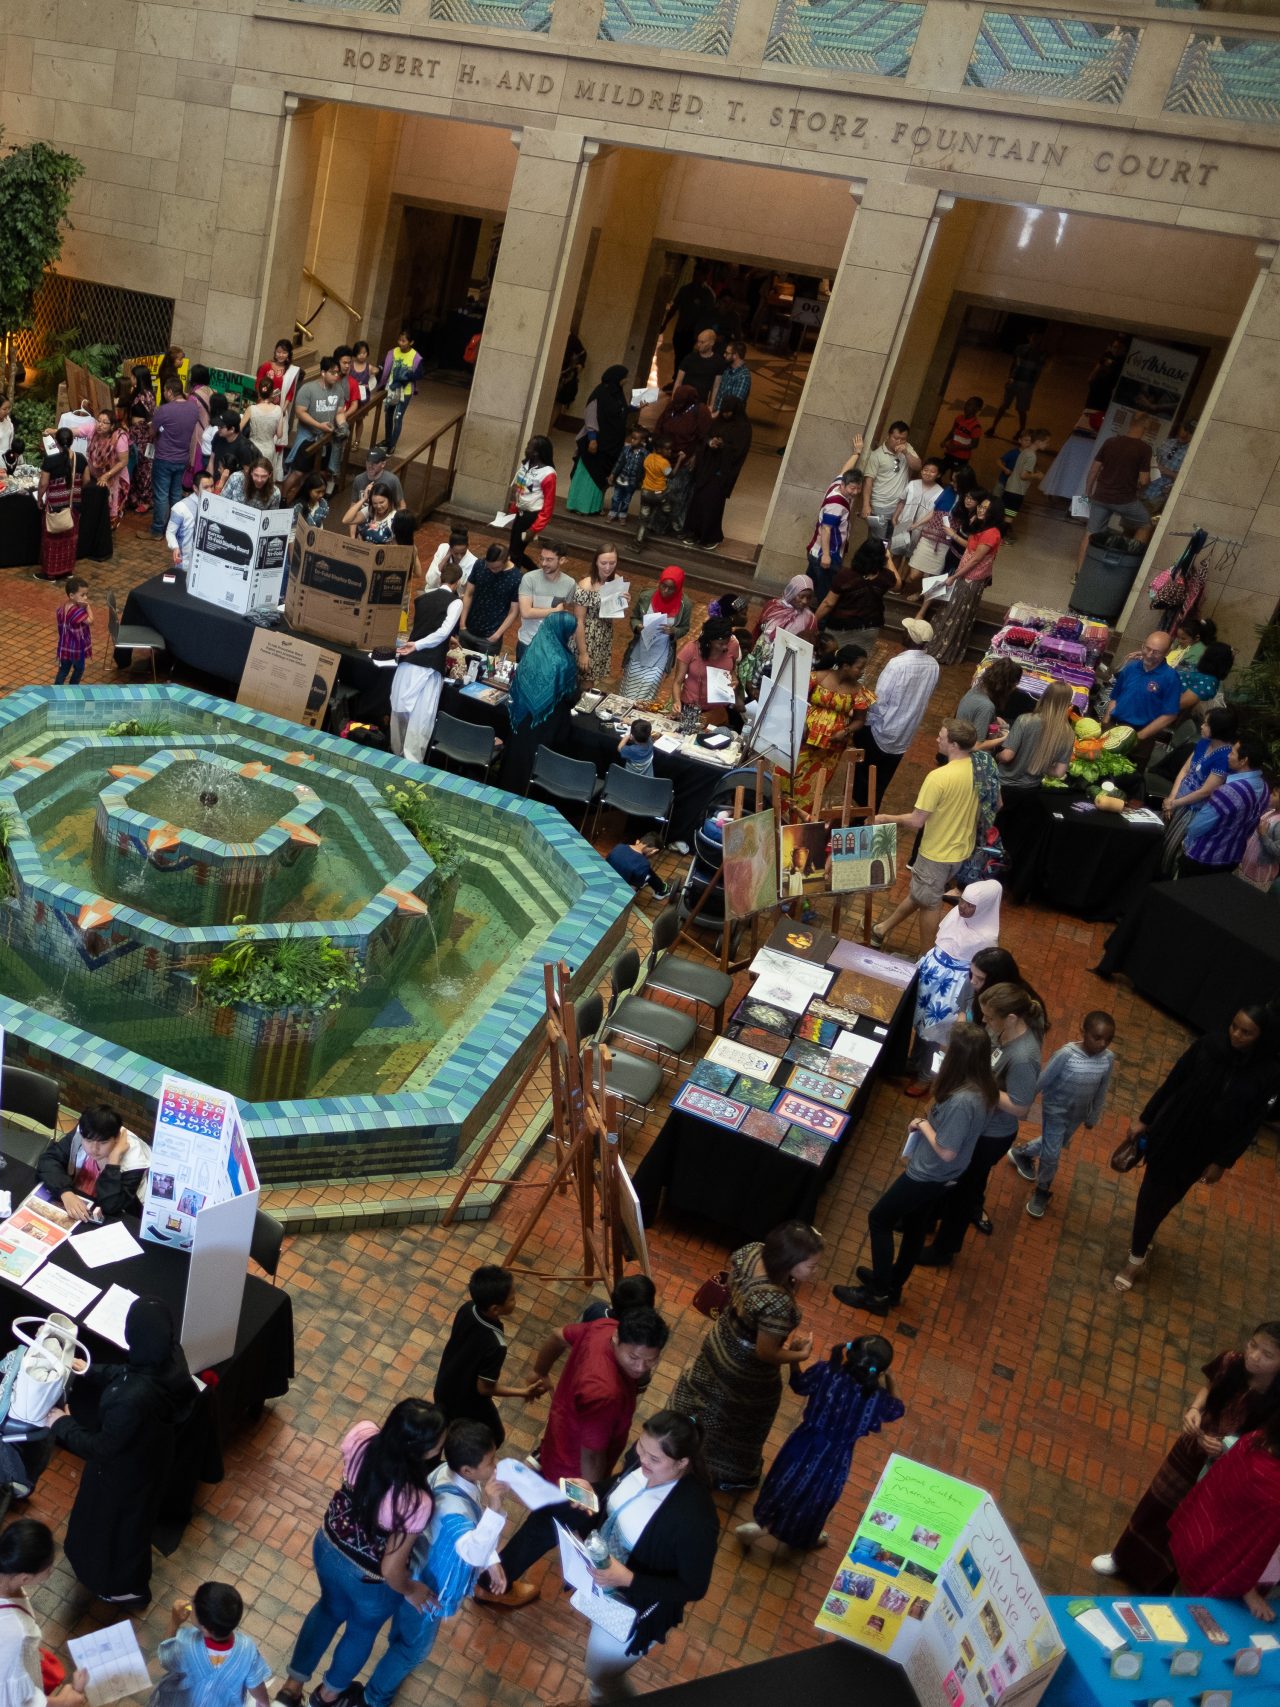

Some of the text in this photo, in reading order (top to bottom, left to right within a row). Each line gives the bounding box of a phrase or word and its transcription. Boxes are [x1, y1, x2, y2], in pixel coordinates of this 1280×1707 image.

[343, 47, 1219, 187] ROBERT H. AND MILDRED T. STORZ FOUNTAIN COURT
